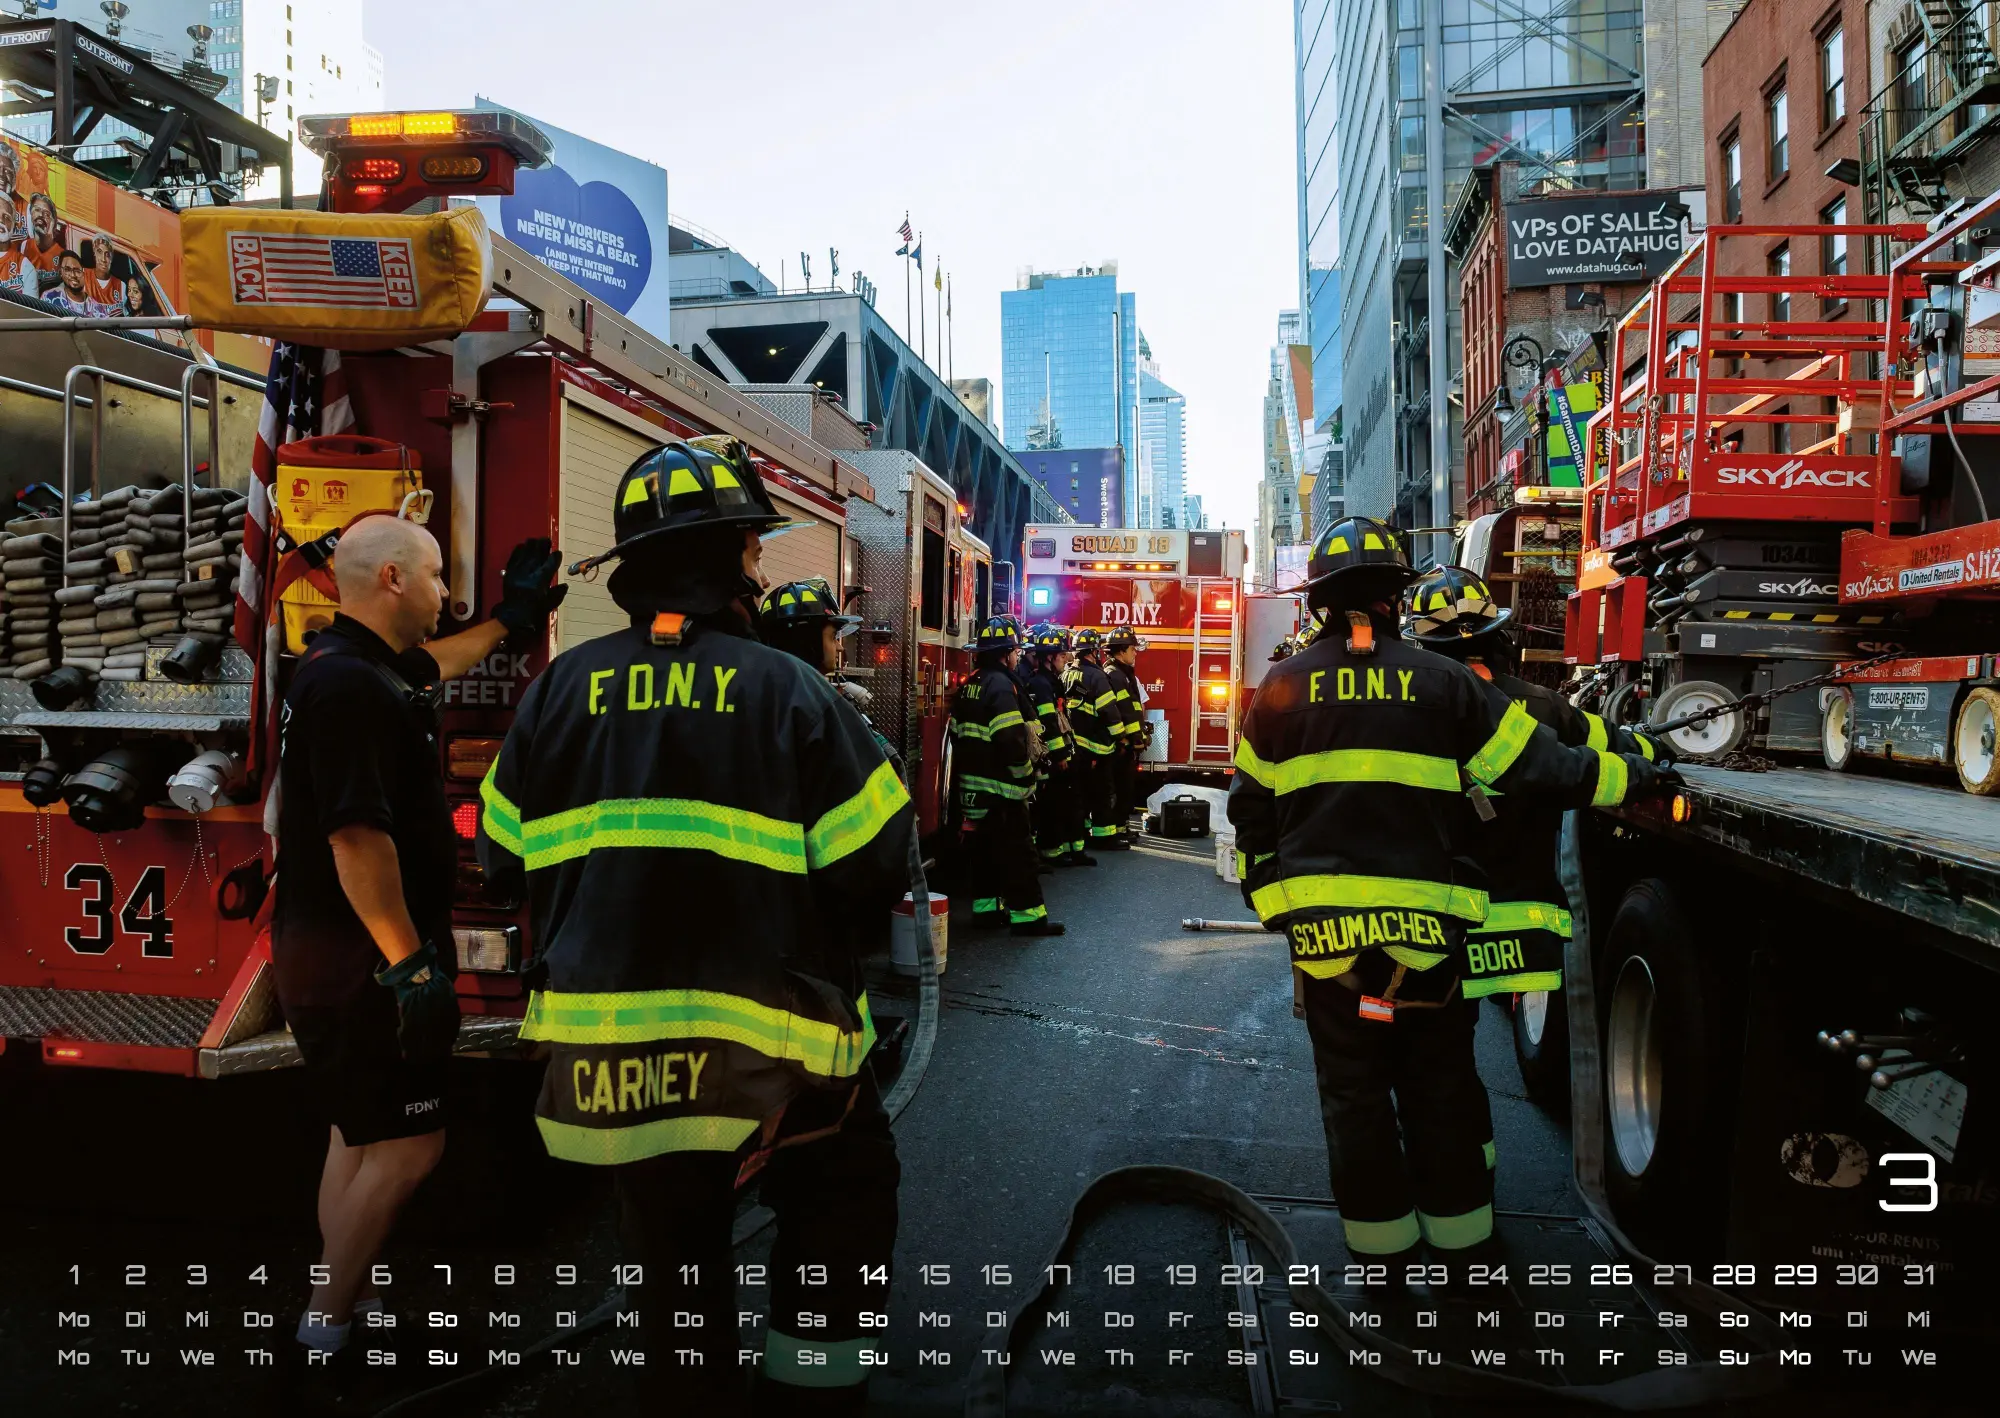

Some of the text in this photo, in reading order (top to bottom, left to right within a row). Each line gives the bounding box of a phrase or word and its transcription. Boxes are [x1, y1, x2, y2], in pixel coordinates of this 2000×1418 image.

[77, 36, 132, 74] OUTFRONT
[534, 208, 625, 250] NEW YORKERS
[1511, 217, 1558, 240] VPs
[1561, 214, 1595, 235] OF
[1601, 210, 1678, 234] SALES
[517, 218, 639, 268] NEVER MISS A BEAT.
[1513, 233, 1680, 260] LOVE DATAHUG
[232, 238, 265, 302] BACK
[380, 245, 414, 306] KEEP
[545, 246, 614, 275] (AND WE INTEND
[548, 259, 570, 272] KEEP
[571, 265, 580, 274] IT
[581, 268, 603, 282] THAT
[603, 275, 627, 290] WAY.)
[1717, 460, 1872, 490] SKYJACK
[1100, 477, 1109, 506] Sweet
[1072, 535, 1139, 554] SQUAD
[1148, 536, 1171, 554] 18
[1758, 578, 1839, 597] SKYJAC
[1845, 575, 1895, 599] SKYJACK
[1910, 565, 1960, 585] United Rentals
[468, 653, 531, 678] ACK
[444, 680, 515, 706] FEET
[1146, 684, 1165, 693] FEET
[64, 862, 174, 959] 34
[1292, 911, 1447, 956] SCHUMACHER
[1467, 938, 1525, 974] BORI
[573, 1051, 709, 1115] CARNEY
[405, 1097, 440, 1116] FDNY
